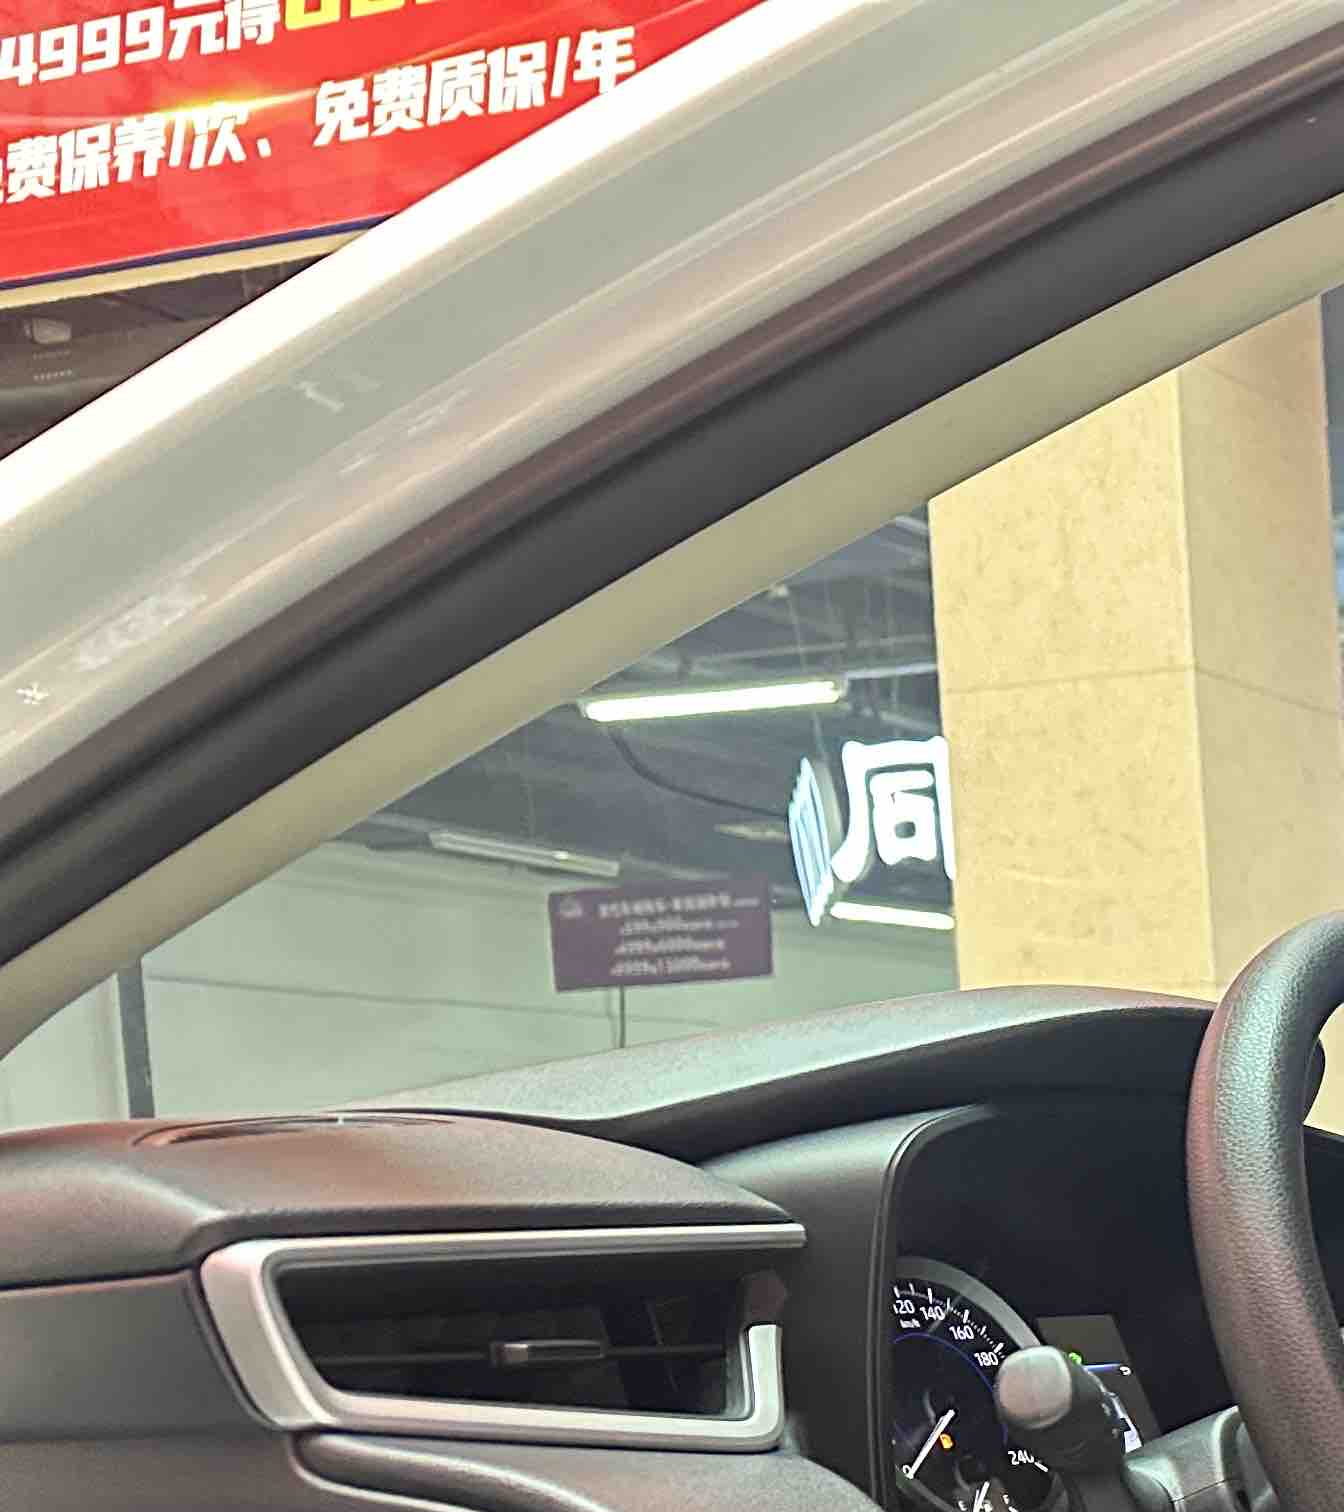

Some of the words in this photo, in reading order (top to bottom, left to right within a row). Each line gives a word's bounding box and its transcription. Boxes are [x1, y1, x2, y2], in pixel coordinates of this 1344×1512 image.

[919, 1305, 946, 1321] 140
[948, 1325, 975, 1340] 160
[973, 1351, 999, 1367] 180
